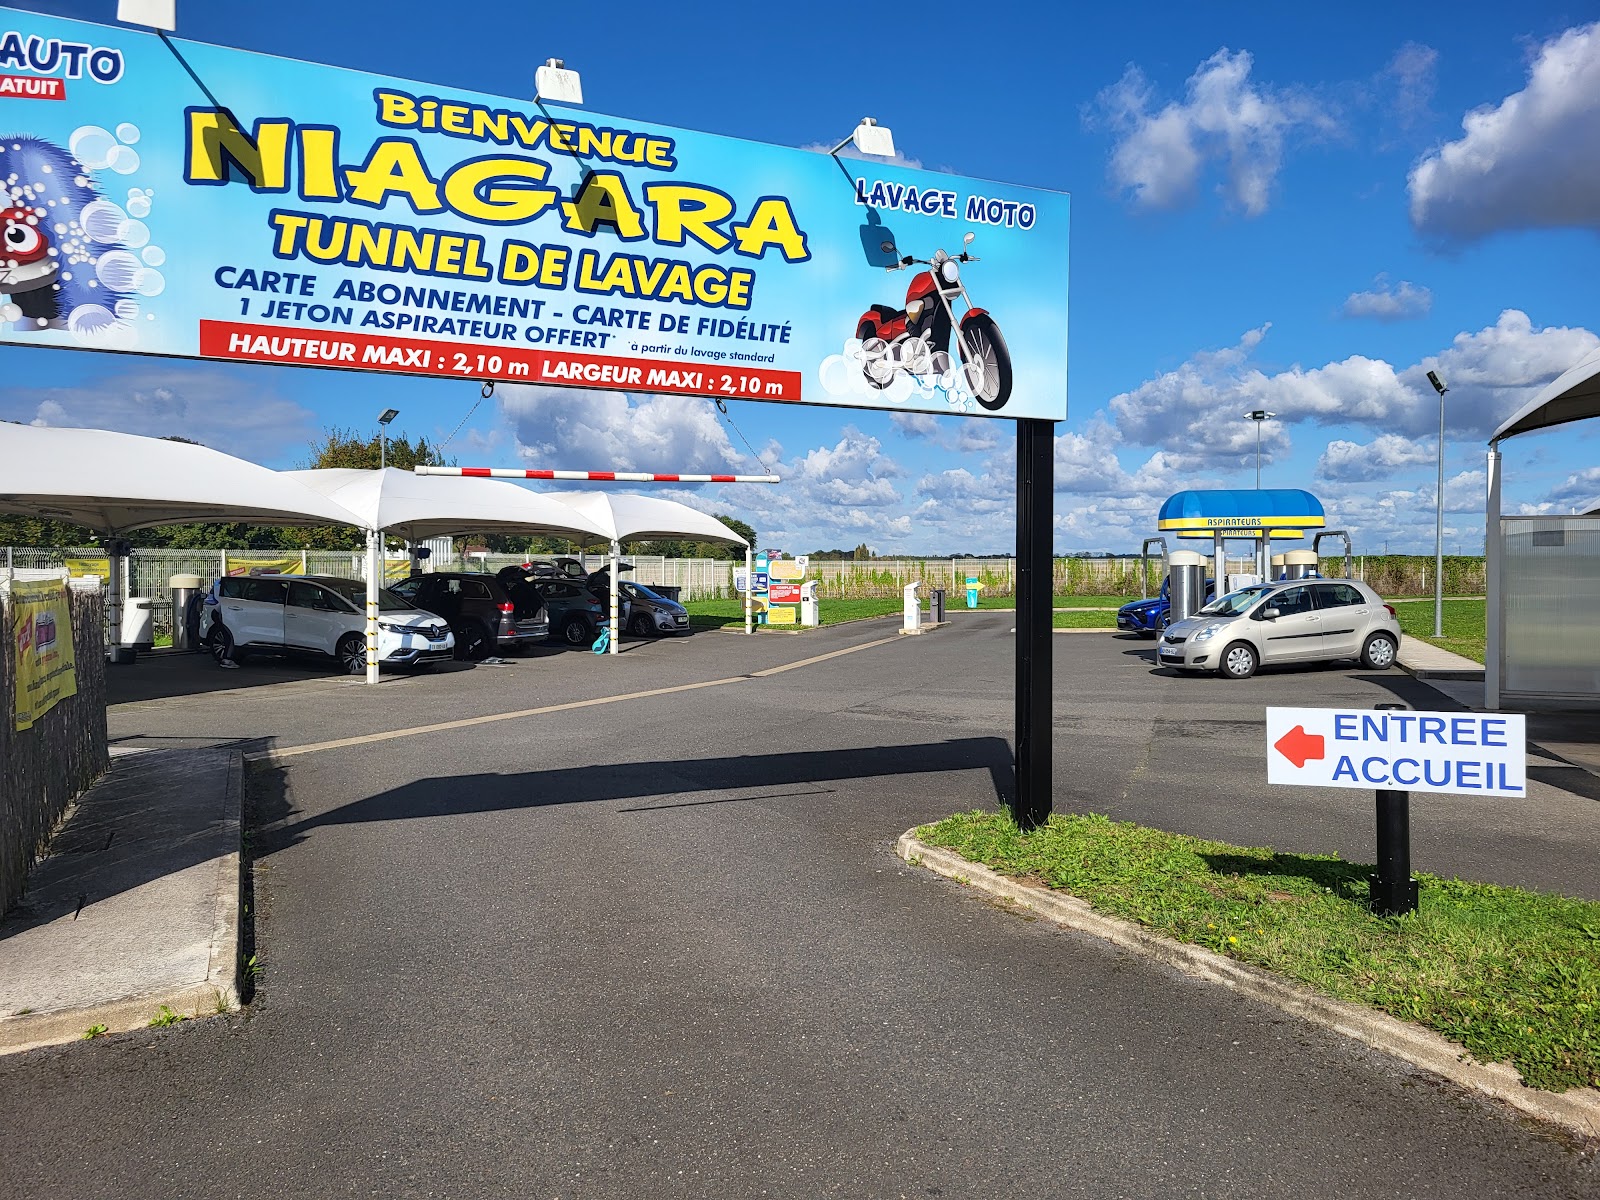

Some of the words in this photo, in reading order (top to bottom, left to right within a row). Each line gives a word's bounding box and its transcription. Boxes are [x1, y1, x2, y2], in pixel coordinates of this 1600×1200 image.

[0, 33, 122, 82] AUTO
[186, 108, 810, 262] NIAGARA
[856, 179, 957, 218] LAVAGE
[966, 196, 1036, 229] MOTO
[271, 211, 493, 283] TUNNEL
[499, 240, 571, 290] DE
[575, 249, 755, 310] LAVAGE
[214, 266, 317, 297] CARTE
[333, 279, 546, 320] ABONNEMENT
[572, 304, 652, 330] CARTE
[658, 314, 691, 334] DE
[697, 316, 792, 344] FIDÉLITÉ
[240, 298, 251, 316] 1
[261, 300, 354, 325] JETON
[360, 310, 518, 341] ASPIRATEUR
[228, 333, 357, 362] HAUTEUR
[362, 345, 431, 368] MAXI
[452, 353, 503, 374] 2,10
[508, 361, 530, 376] m
[641, 344, 671, 354] partir
[674, 345, 688, 356] du
[690, 346, 727, 361] lavage
[729, 350, 775, 363] standard
[542, 359, 642, 385] LARGEUR
[646, 368, 703, 390] MAXI
[719, 374, 761, 395] 2,10
[765, 381, 784, 396] m
[1207, 518, 1262, 526] ASPIRATEURS
[1334, 714, 1508, 747] ENTREE
[1332, 755, 1523, 791] ACCUEIL
